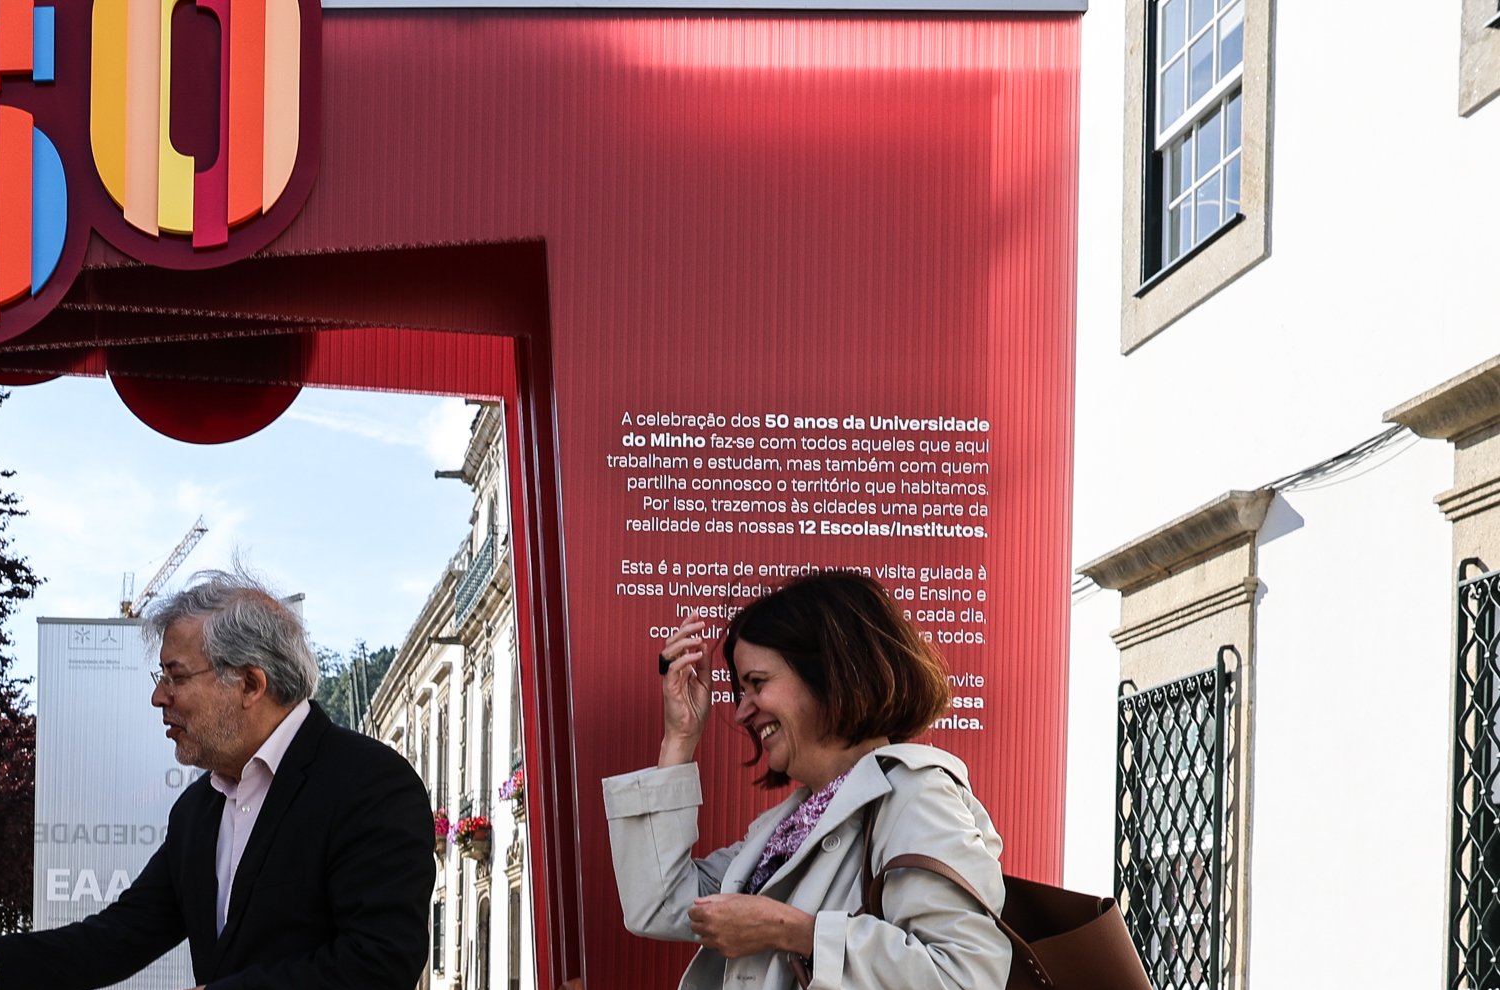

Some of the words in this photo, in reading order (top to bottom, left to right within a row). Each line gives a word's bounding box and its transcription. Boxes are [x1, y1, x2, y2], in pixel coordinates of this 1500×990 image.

[622, 412, 632, 425] A
[637, 411, 726, 430] celebração
[731, 413, 760, 428] dos
[765, 414, 789, 428] 50
[794, 417, 838, 429] anos
[843, 415, 865, 429] da
[870, 415, 990, 432] Universidade
[622, 432, 646, 447] do
[651, 432, 706, 448] Minho
[710, 433, 754, 449] faz-se
[760, 438, 796, 449] com
[801, 435, 847, 450] todos
[852, 437, 914, 454] aqueles
[920, 440, 950, 455] que
[955, 439, 989, 455] aqui
[607, 453, 688, 468] trabalham
[694, 457, 703, 469] e
[708, 455, 782, 472] estudam,
[787, 459, 821, 471] mas
[825, 457, 894, 472] também
[900, 461, 936, 473] com
[942, 462, 988, 476] quem
[628, 475, 686, 491] partilha
[692, 478, 772, 491] connosco
[777, 480, 786, 491] o
[791, 477, 860, 493] território
[865, 482, 896, 496] que
[901, 479, 988, 495] habitamos.
[644, 496, 669, 510] Por
[674, 496, 707, 512] isso,
[711, 498, 786, 512] trazemos
[791, 498, 808, 513] às
[813, 499, 876, 514] cidades
[882, 503, 917, 515] uma
[923, 503, 963, 518] parte
[969, 502, 988, 516] da
[627, 517, 700, 532] realidade
[705, 518, 733, 533] das
[738, 521, 794, 534] nossas
[798, 520, 816, 534] 12
[821, 521, 988, 538] Escolas/Institutos.
[622, 560, 653, 574] Esta
[658, 559, 667, 574] é
[673, 563, 681, 575] a
[687, 562, 728, 578] porta
[733, 561, 753, 576] de
[876, 564, 915, 579] visita
[920, 565, 973, 582] guiada
[978, 565, 986, 580] à
[617, 583, 663, 596] nossa
[669, 582, 771, 597] Universidade
[894, 585, 914, 600] de
[920, 586, 971, 601] Ensino
[977, 590, 986, 601] e
[917, 607, 955, 622] cada
[960, 608, 986, 624] dia,
[937, 629, 985, 644] todos.
[46, 868, 144, 903] EAA
